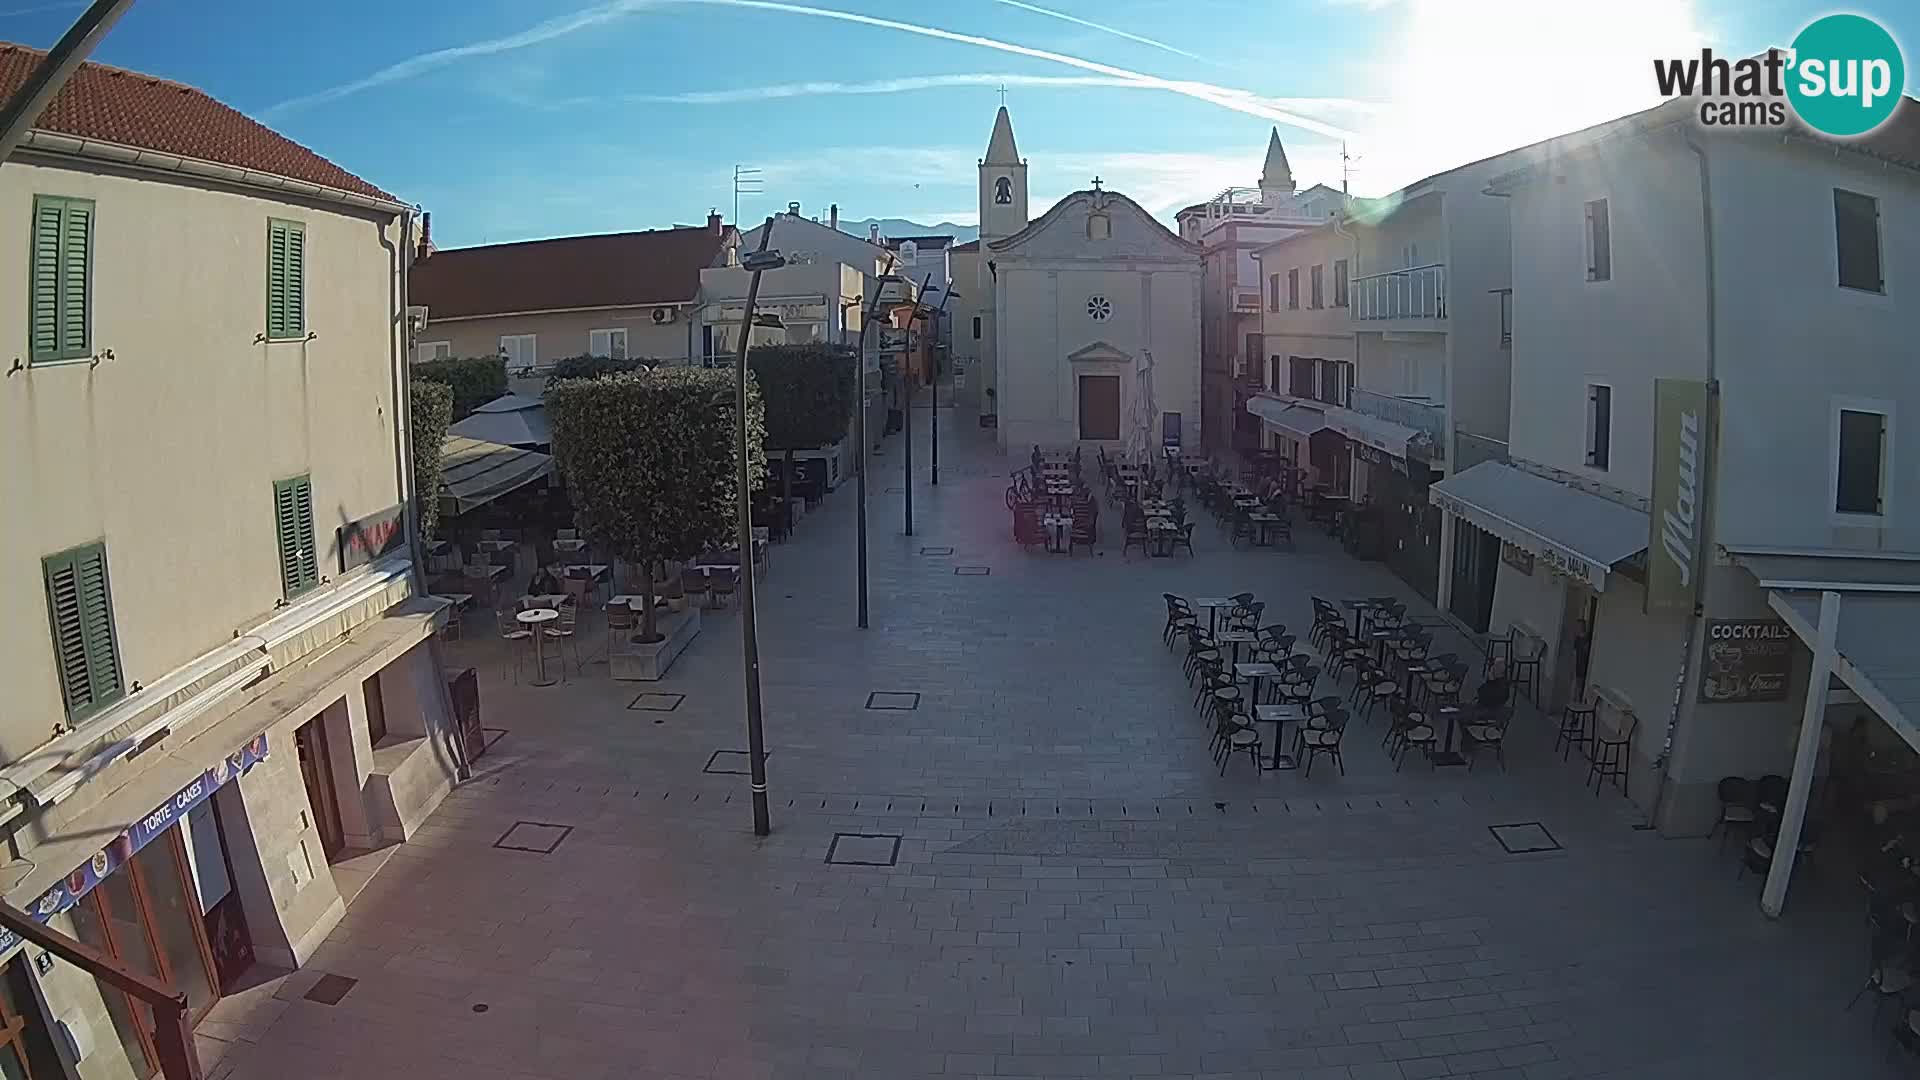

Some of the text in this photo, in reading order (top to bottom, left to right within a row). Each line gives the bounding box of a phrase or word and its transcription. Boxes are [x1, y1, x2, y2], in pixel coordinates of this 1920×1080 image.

[1711, 624, 1791, 639] COCKTAILS
[143, 780, 202, 834] TORTE CAKES
